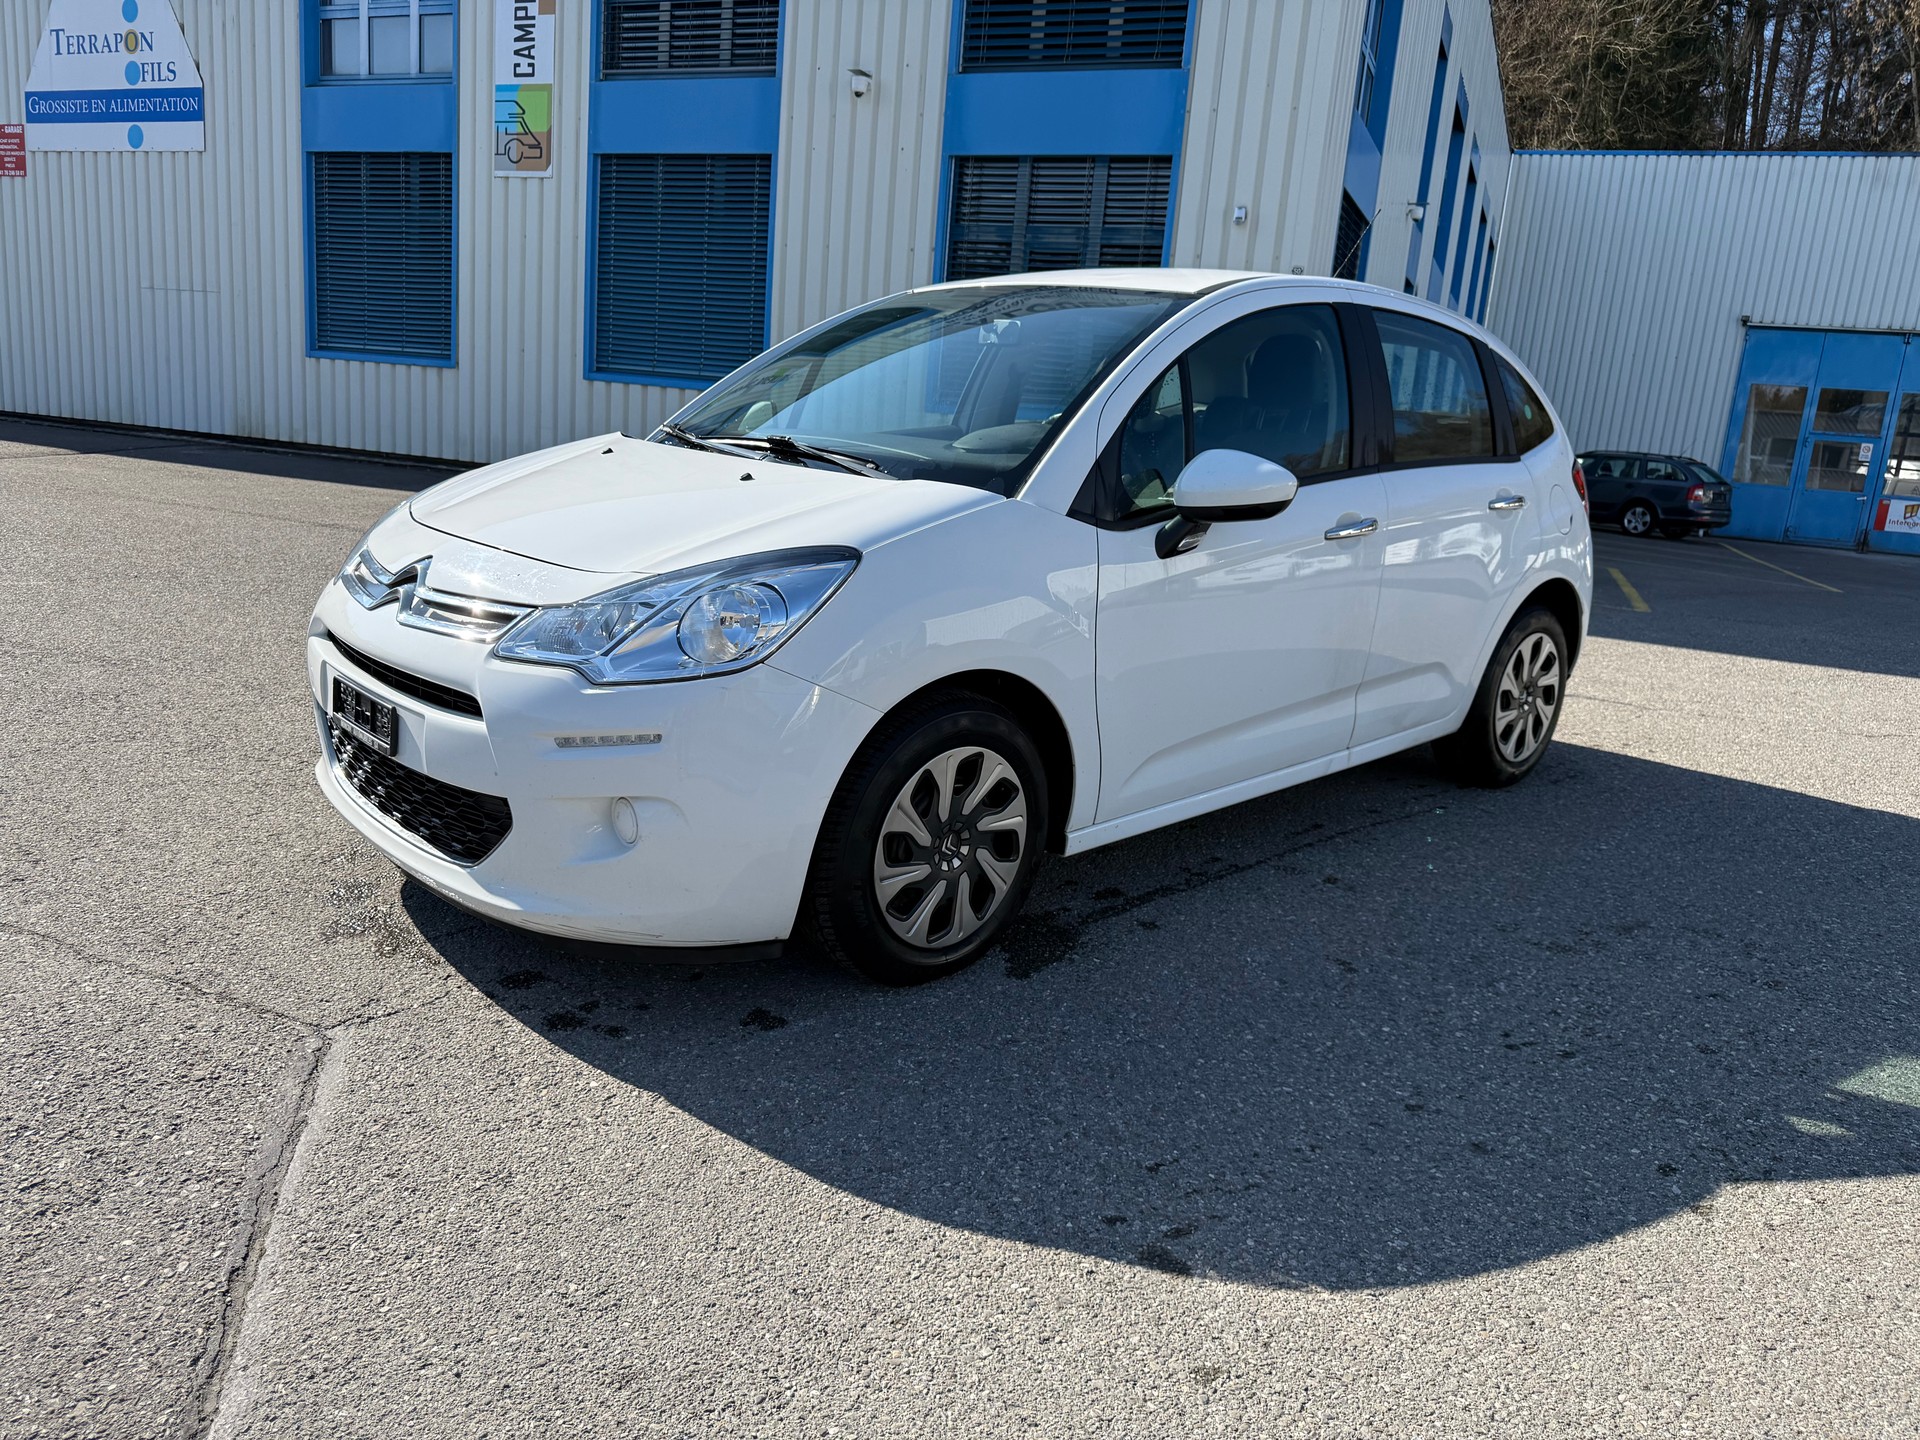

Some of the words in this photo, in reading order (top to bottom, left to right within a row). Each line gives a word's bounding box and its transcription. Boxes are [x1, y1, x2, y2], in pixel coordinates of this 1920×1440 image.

[50, 28, 154, 55] TERRAPON
[140, 61, 177, 82] FILS
[28, 96, 89, 114] GROSSISTE
[91, 98, 106, 113] EN
[109, 97, 198, 112] ALIMENTATION
